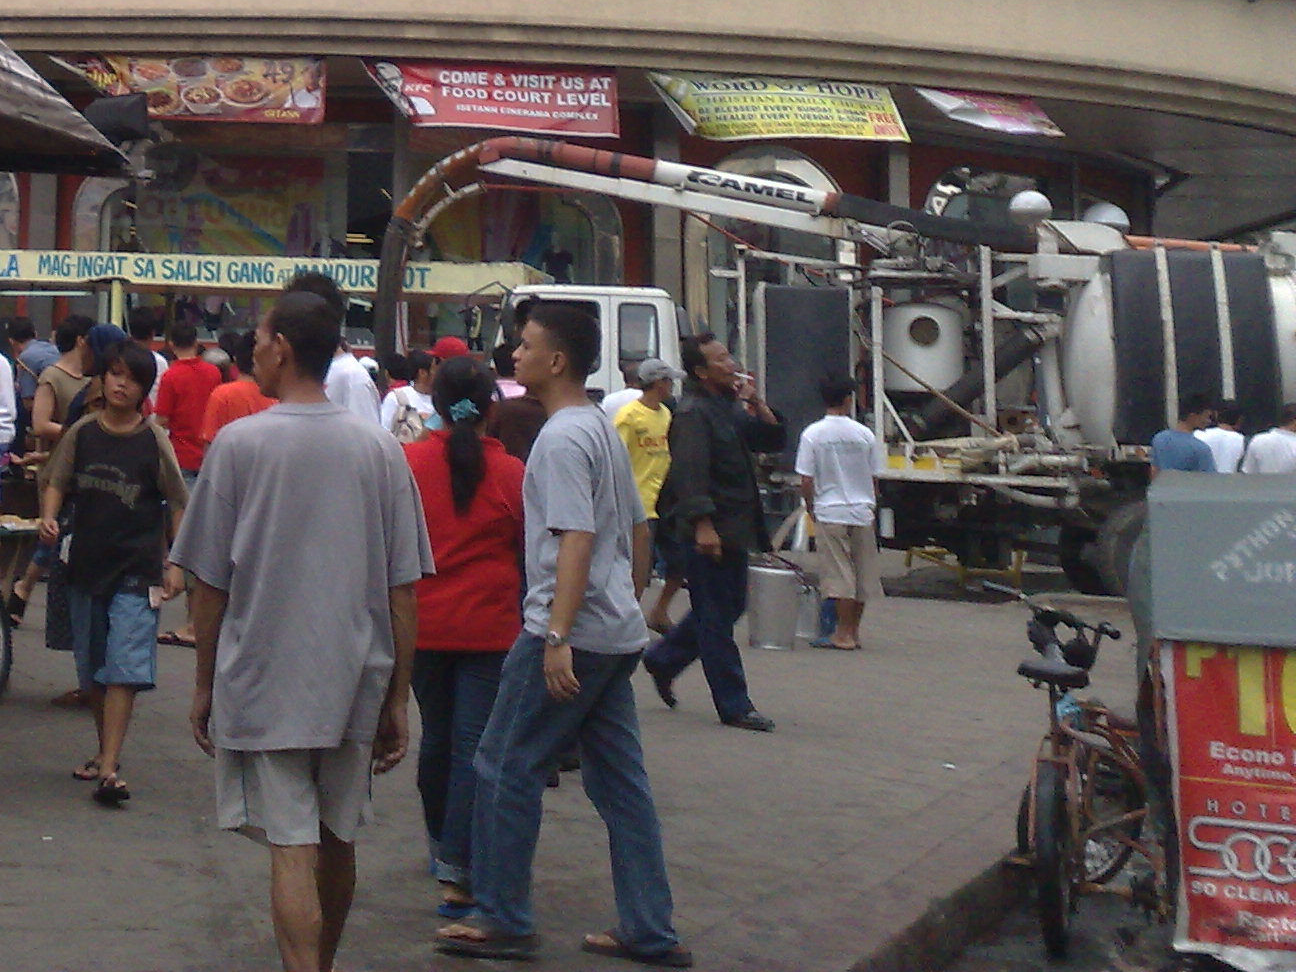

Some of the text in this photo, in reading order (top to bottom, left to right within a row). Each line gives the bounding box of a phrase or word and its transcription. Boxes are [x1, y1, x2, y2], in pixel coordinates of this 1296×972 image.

[404, 83, 432, 93] KFC
[439, 70, 612, 91] COME & VISIT US AT
[690, 78, 768, 94] WORD
[817, 81, 884, 102] HOPE
[441, 86, 612, 107] FOOD COURT LEVEL
[686, 169, 814, 204] CAMEL
[38, 255, 127, 277] MAG-INGAT
[133, 257, 156, 277] SA
[162, 259, 222, 282] SALISI
[227, 262, 274, 284] GANG
[1209, 741, 1286, 765] Econo
